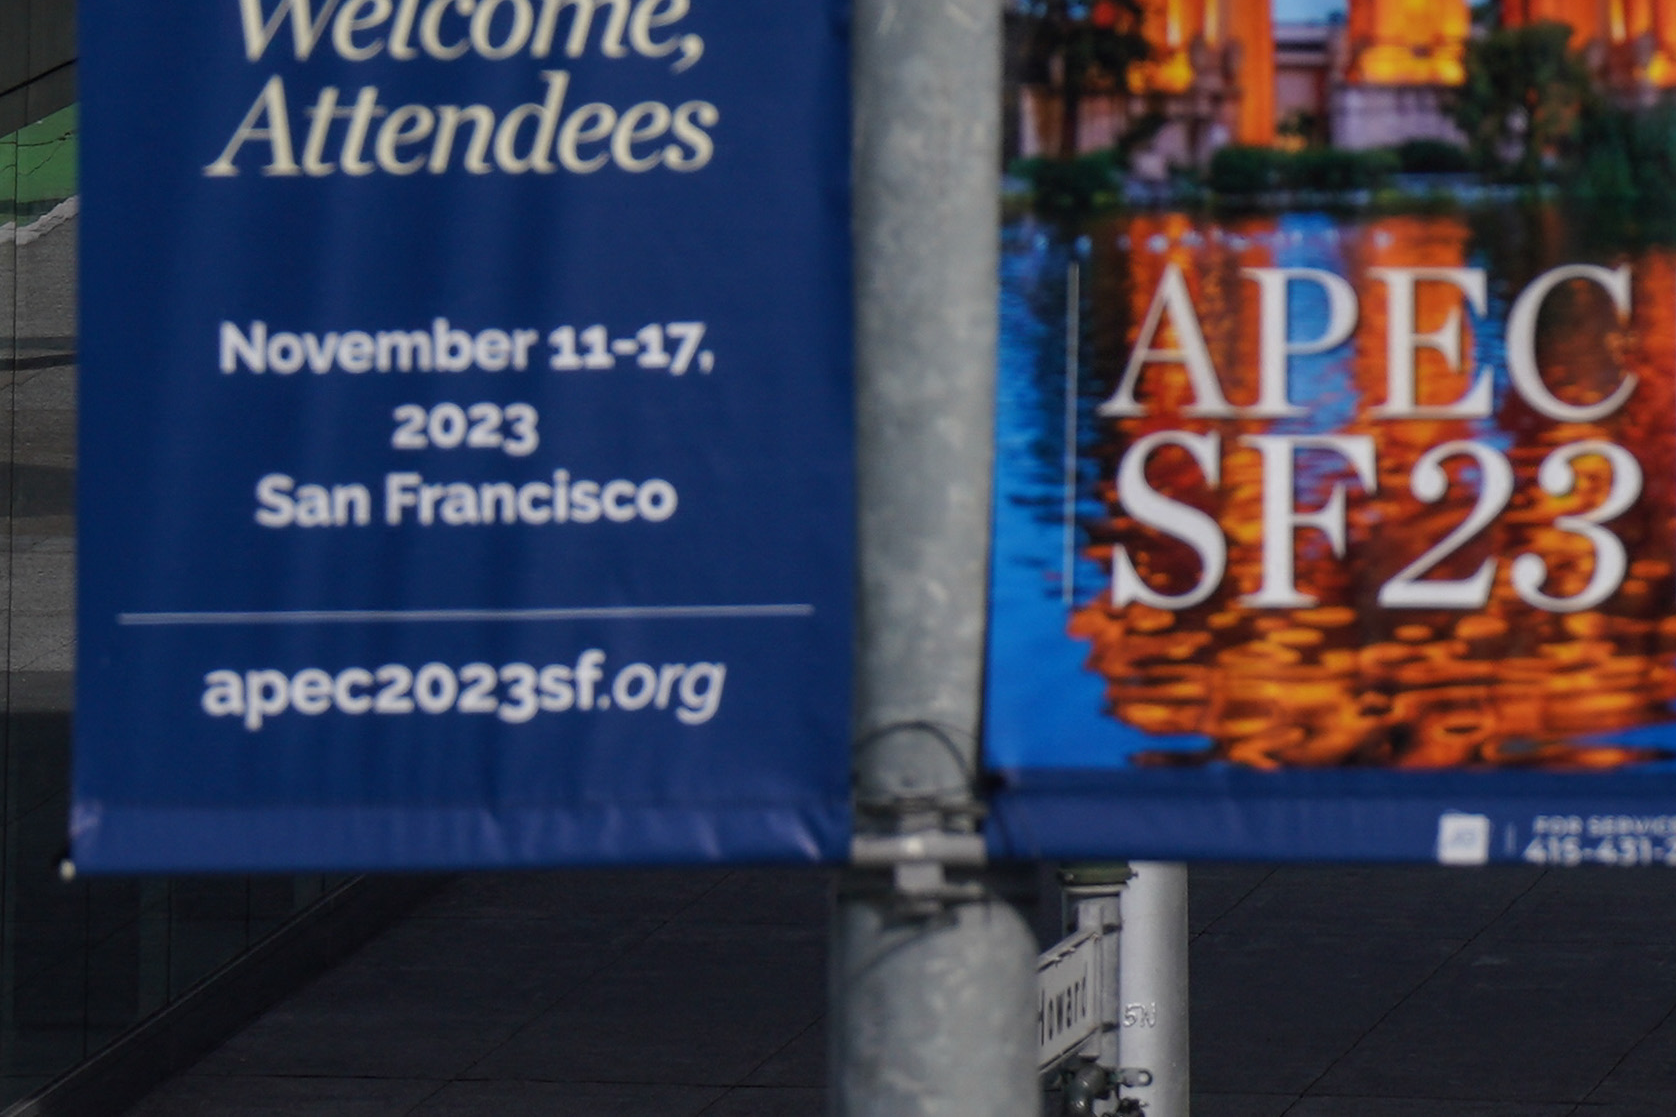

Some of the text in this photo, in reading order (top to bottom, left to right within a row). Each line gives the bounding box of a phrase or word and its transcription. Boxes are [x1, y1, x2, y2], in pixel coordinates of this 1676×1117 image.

[204, 69, 720, 177] Attendees
[219, 318, 715, 375] November 11-17,
[1097, 260, 1640, 424] APEC
[391, 403, 539, 457] 2023
[254, 469, 678, 528] San Francisco
[202, 650, 727, 730] apec2023sf.org
[1532, 814, 1583, 838] FOR
